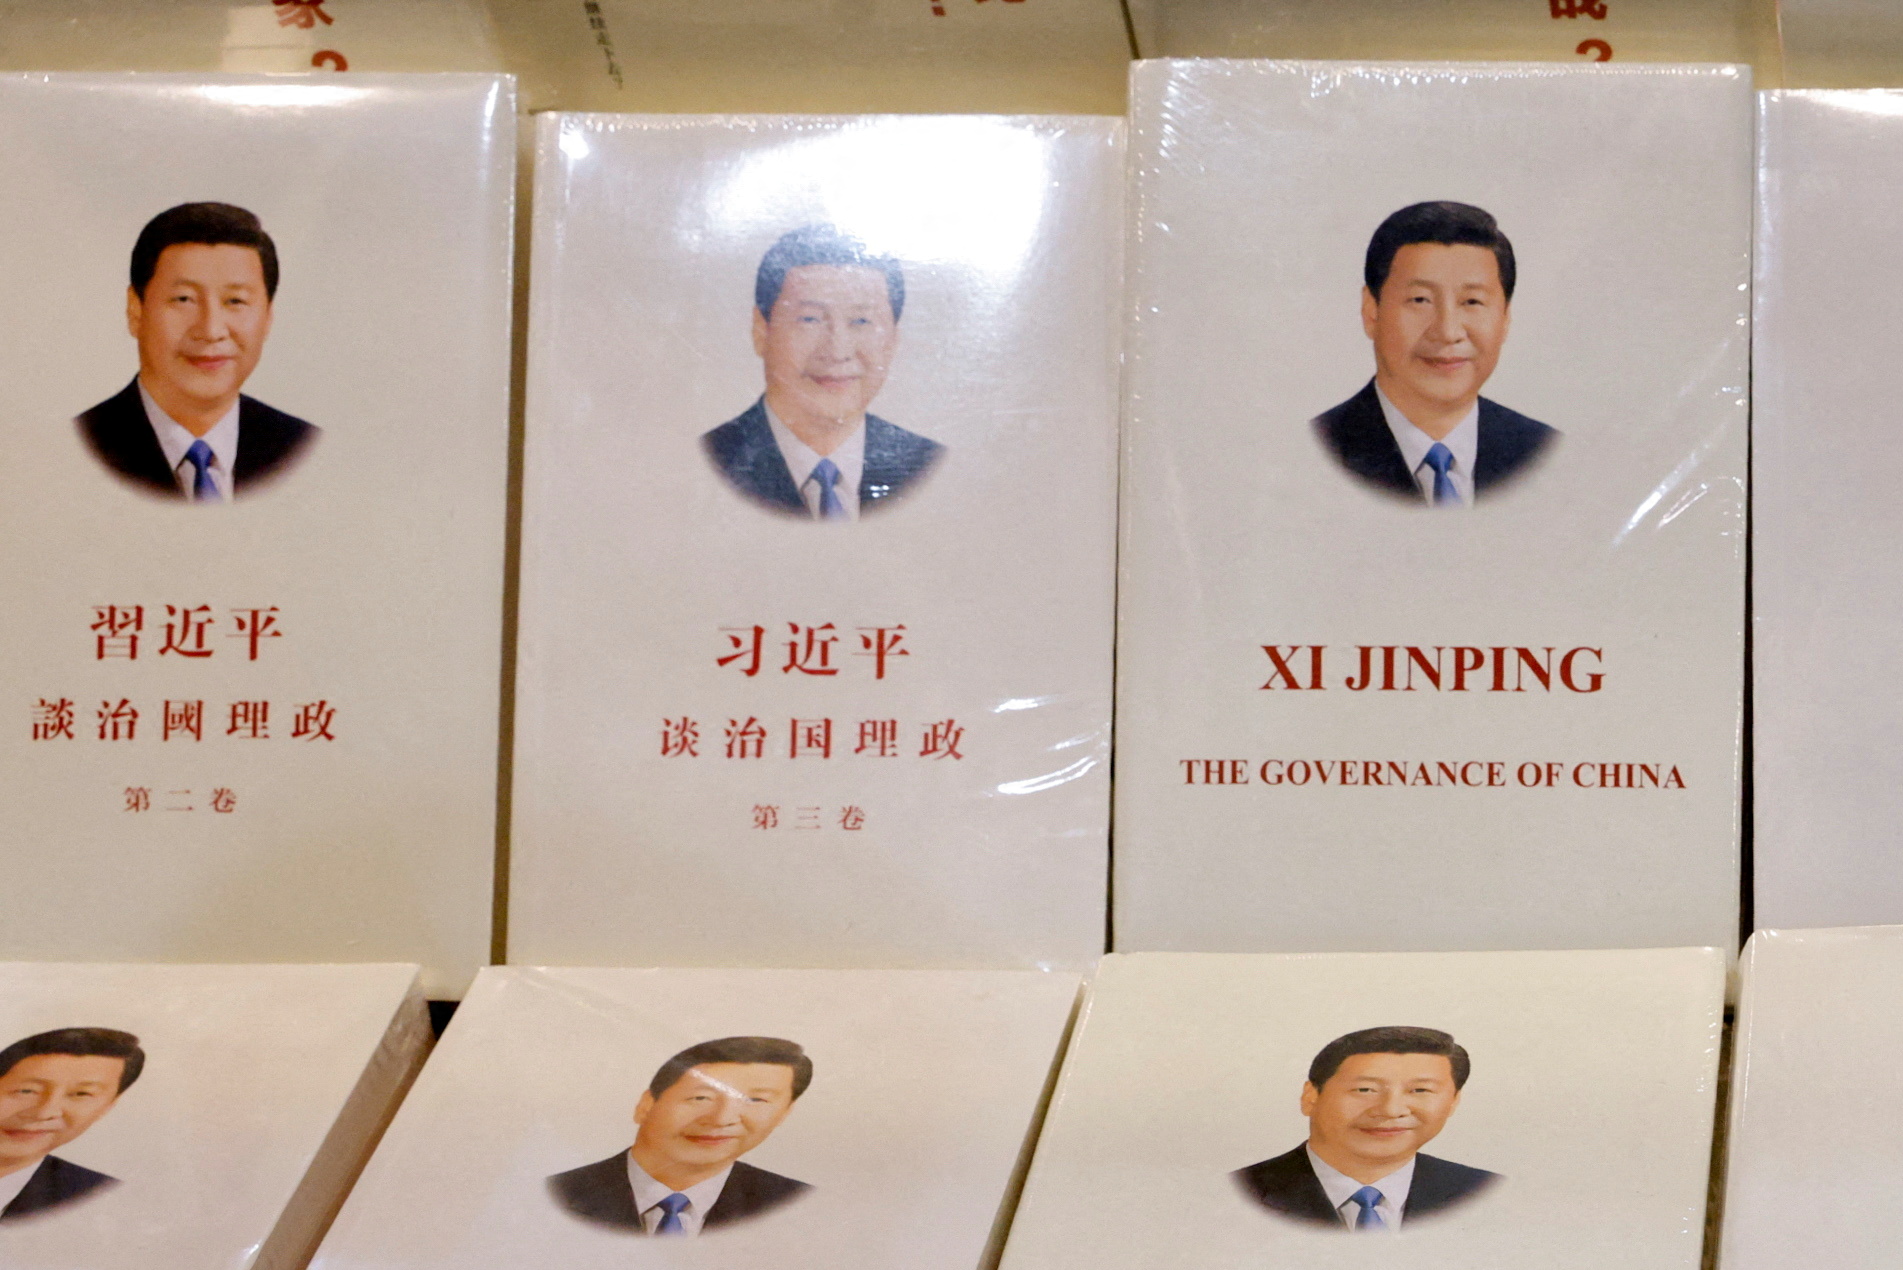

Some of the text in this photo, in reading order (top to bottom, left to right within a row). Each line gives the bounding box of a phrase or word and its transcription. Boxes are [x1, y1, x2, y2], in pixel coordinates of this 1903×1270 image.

[88, 603, 284, 663] 習近平
[716, 621, 912, 681] 习近平
[1259, 644, 1606, 694] XI JINPING
[31, 696, 338, 743] 談治國理政
[660, 715, 966, 761] 谈治国理政
[1180, 759, 1687, 789] THE GOVERNANCE OF CHINA
[124, 786, 238, 815] 第二卷
[751, 804, 866, 831] 第三卷
